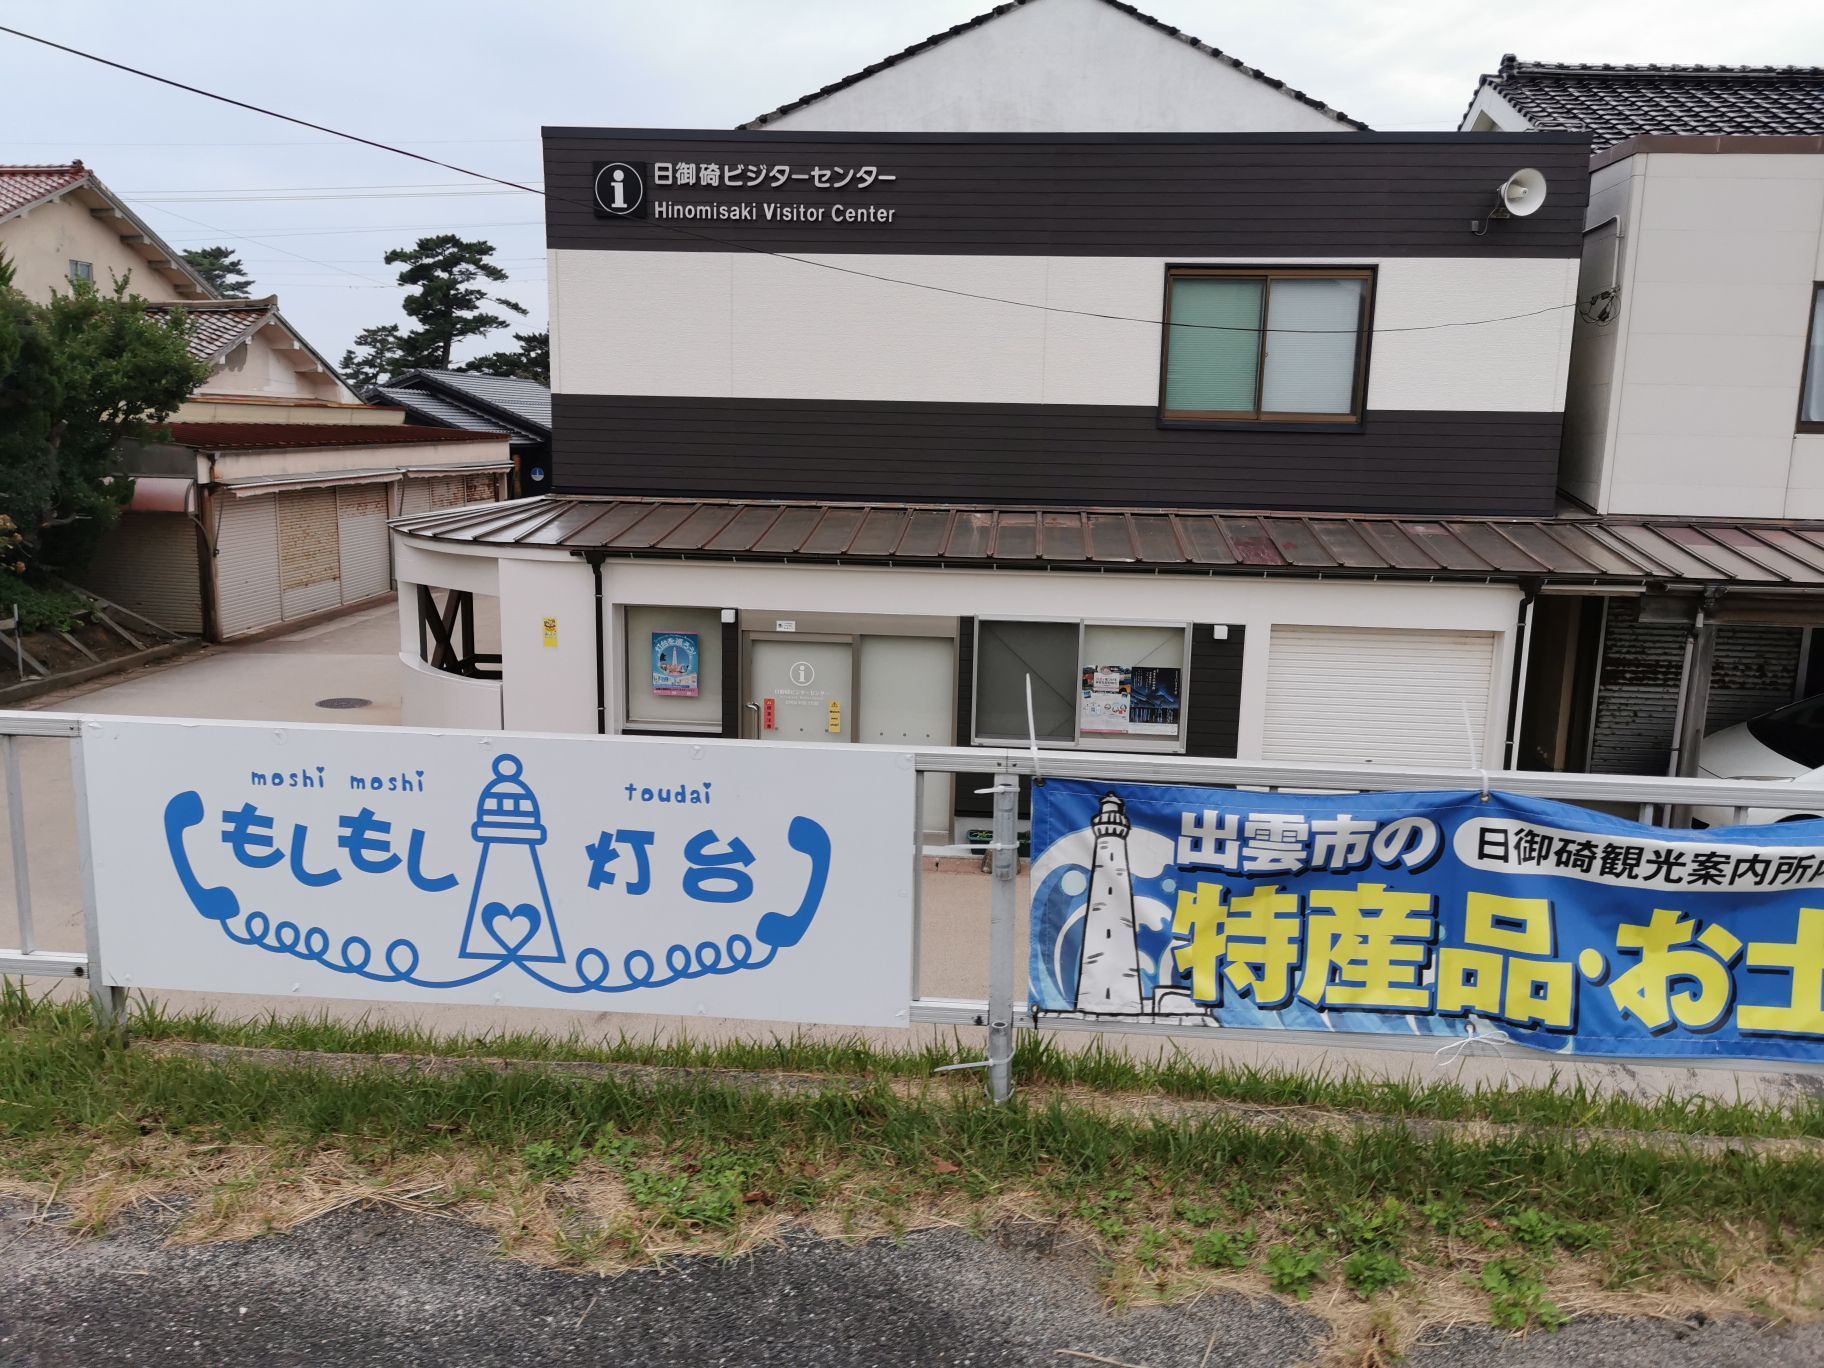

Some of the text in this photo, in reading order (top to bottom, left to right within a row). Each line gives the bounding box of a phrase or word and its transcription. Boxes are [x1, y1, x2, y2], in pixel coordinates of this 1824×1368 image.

[654, 161, 897, 189] 日御碕ビジターセンター
[654, 201, 895, 223] Hinomisaki Visitor Center
[251, 767, 712, 804] moshi moshi toudai
[220, 802, 757, 904] もしもし 灯台
[1176, 809, 1438, 872] 出雲市の
